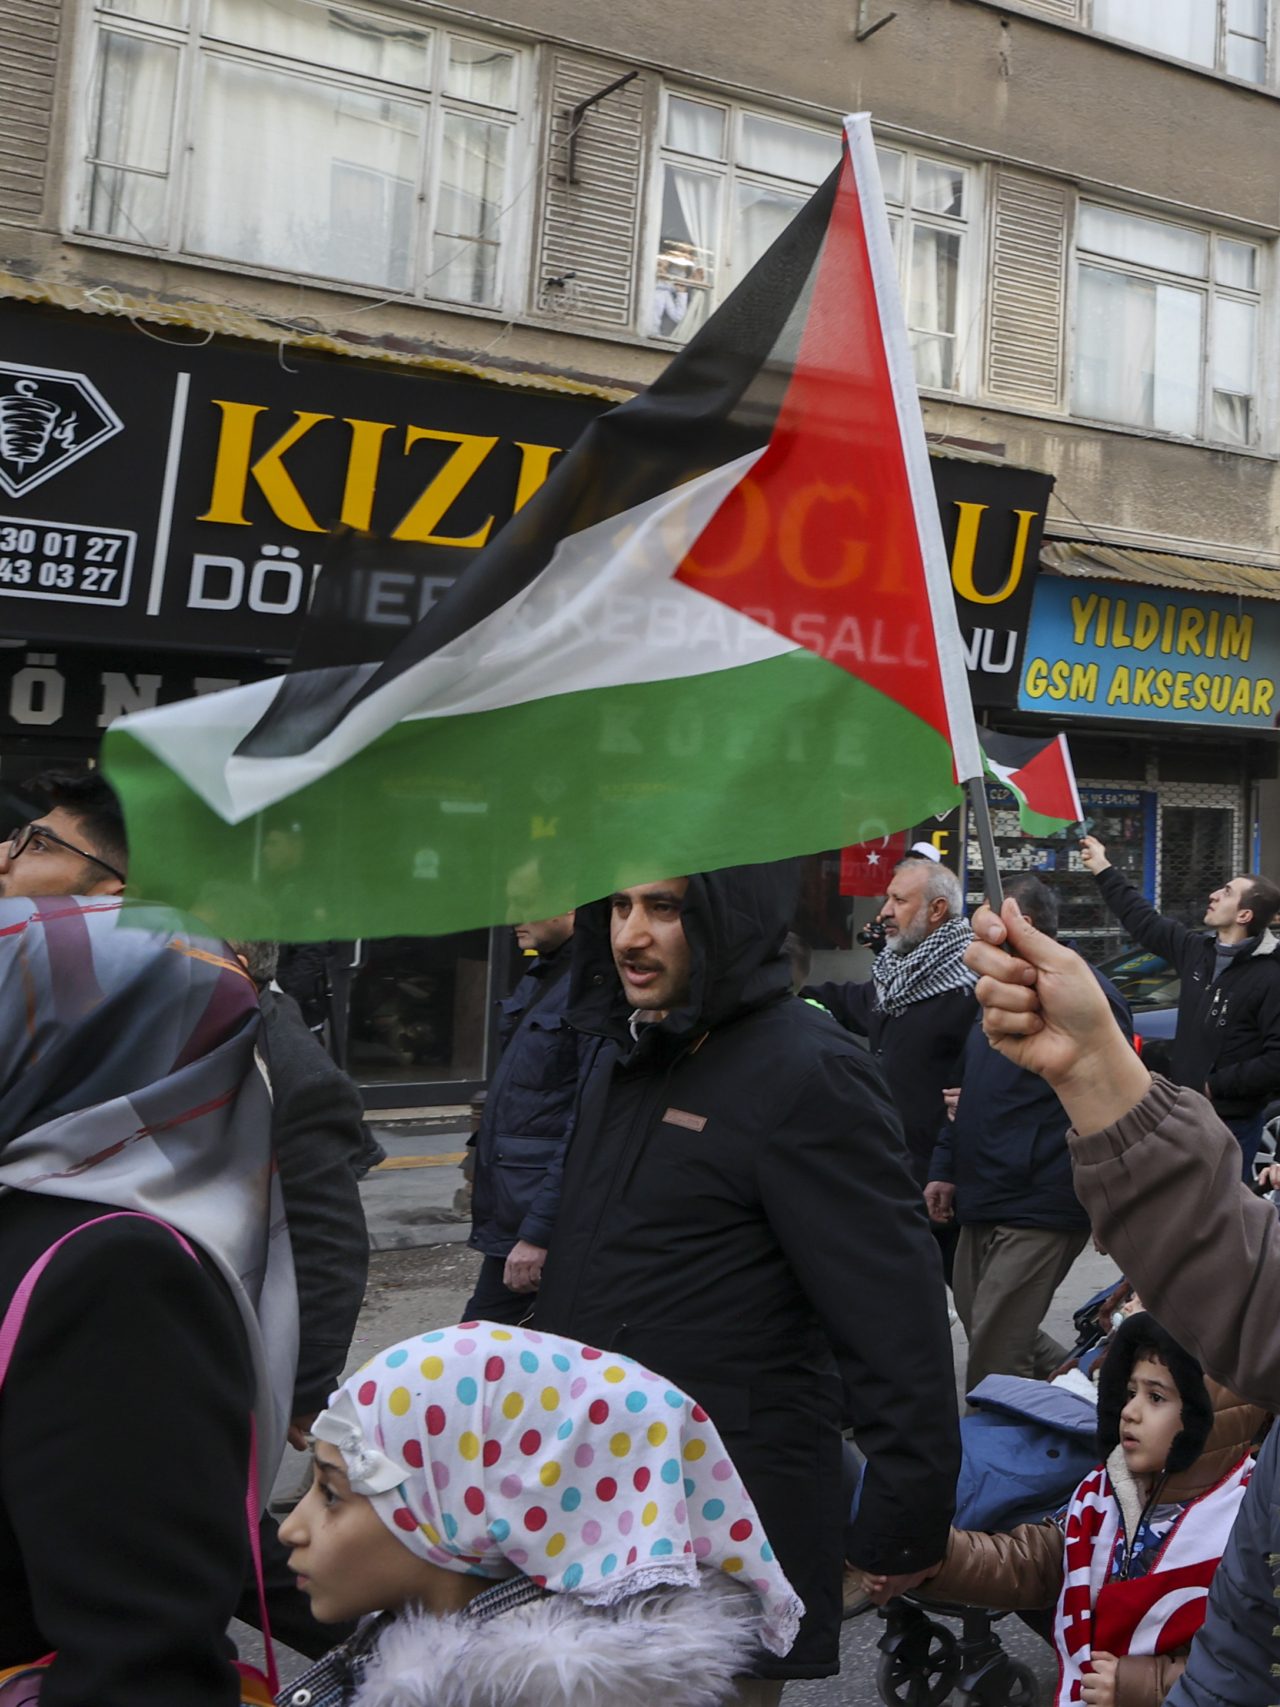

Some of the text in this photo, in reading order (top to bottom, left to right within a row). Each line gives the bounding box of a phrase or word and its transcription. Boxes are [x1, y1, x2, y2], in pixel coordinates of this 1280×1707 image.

[42, 531, 77, 558] 01
[84, 536, 122, 562] 27
[0, 557, 118, 592] 43 03 27
[1070, 593, 1254, 662] YILDIRIM
[1025, 657, 1276, 717] GSM AKSESUAR
